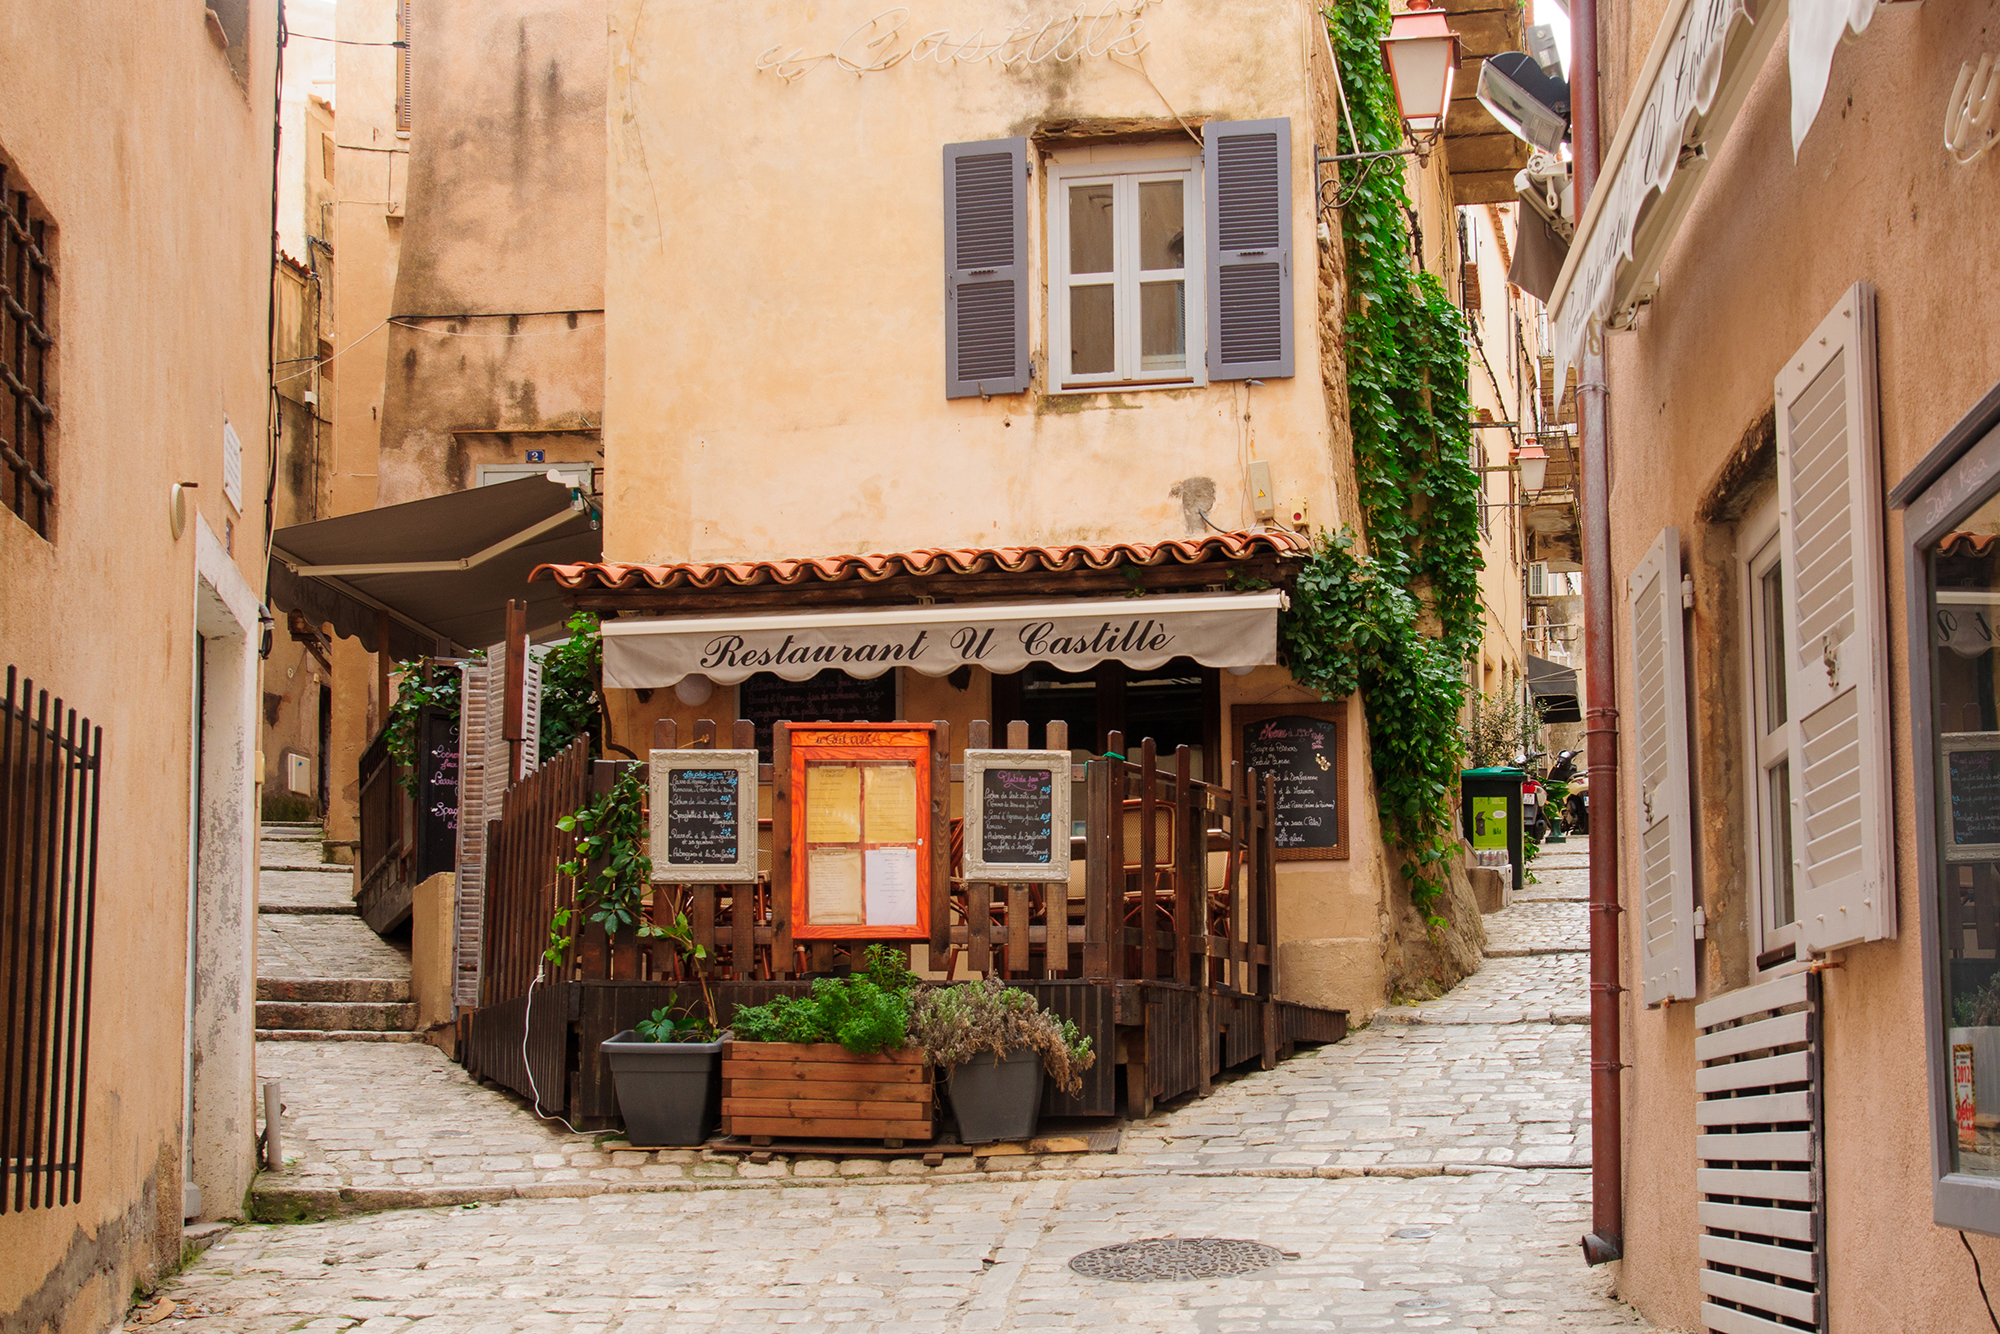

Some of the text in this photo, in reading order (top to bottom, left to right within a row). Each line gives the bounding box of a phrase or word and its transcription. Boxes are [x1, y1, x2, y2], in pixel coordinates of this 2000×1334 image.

[531, 451, 539, 461] 2
[700, 620, 1176, 669] Restaurant U Castillè
[1957, 1065, 1971, 1084] 2012
